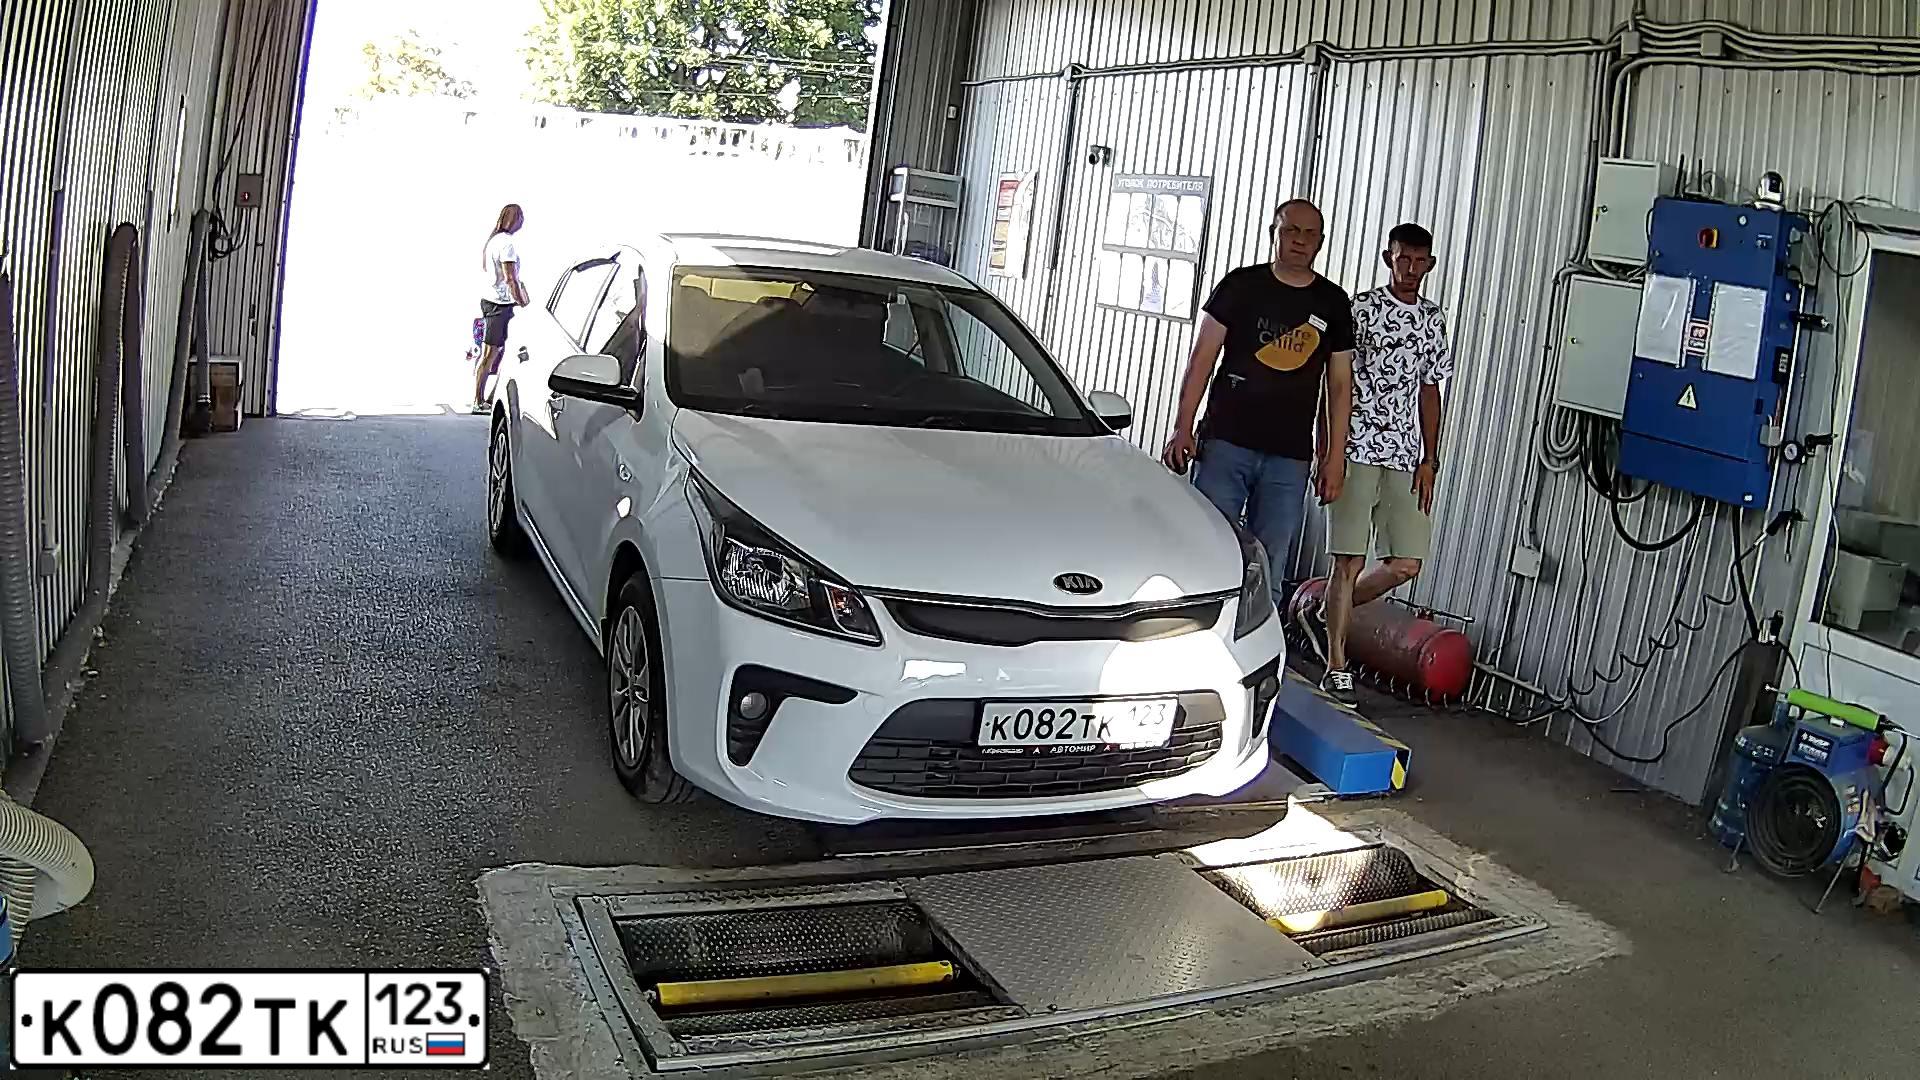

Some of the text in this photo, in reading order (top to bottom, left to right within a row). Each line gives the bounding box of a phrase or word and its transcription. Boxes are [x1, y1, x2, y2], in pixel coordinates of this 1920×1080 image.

[1061, 575, 1097, 589] KIA
[990, 708, 1113, 740] К082ТК
[1050, 745, 1096, 753] АВТОМИР
